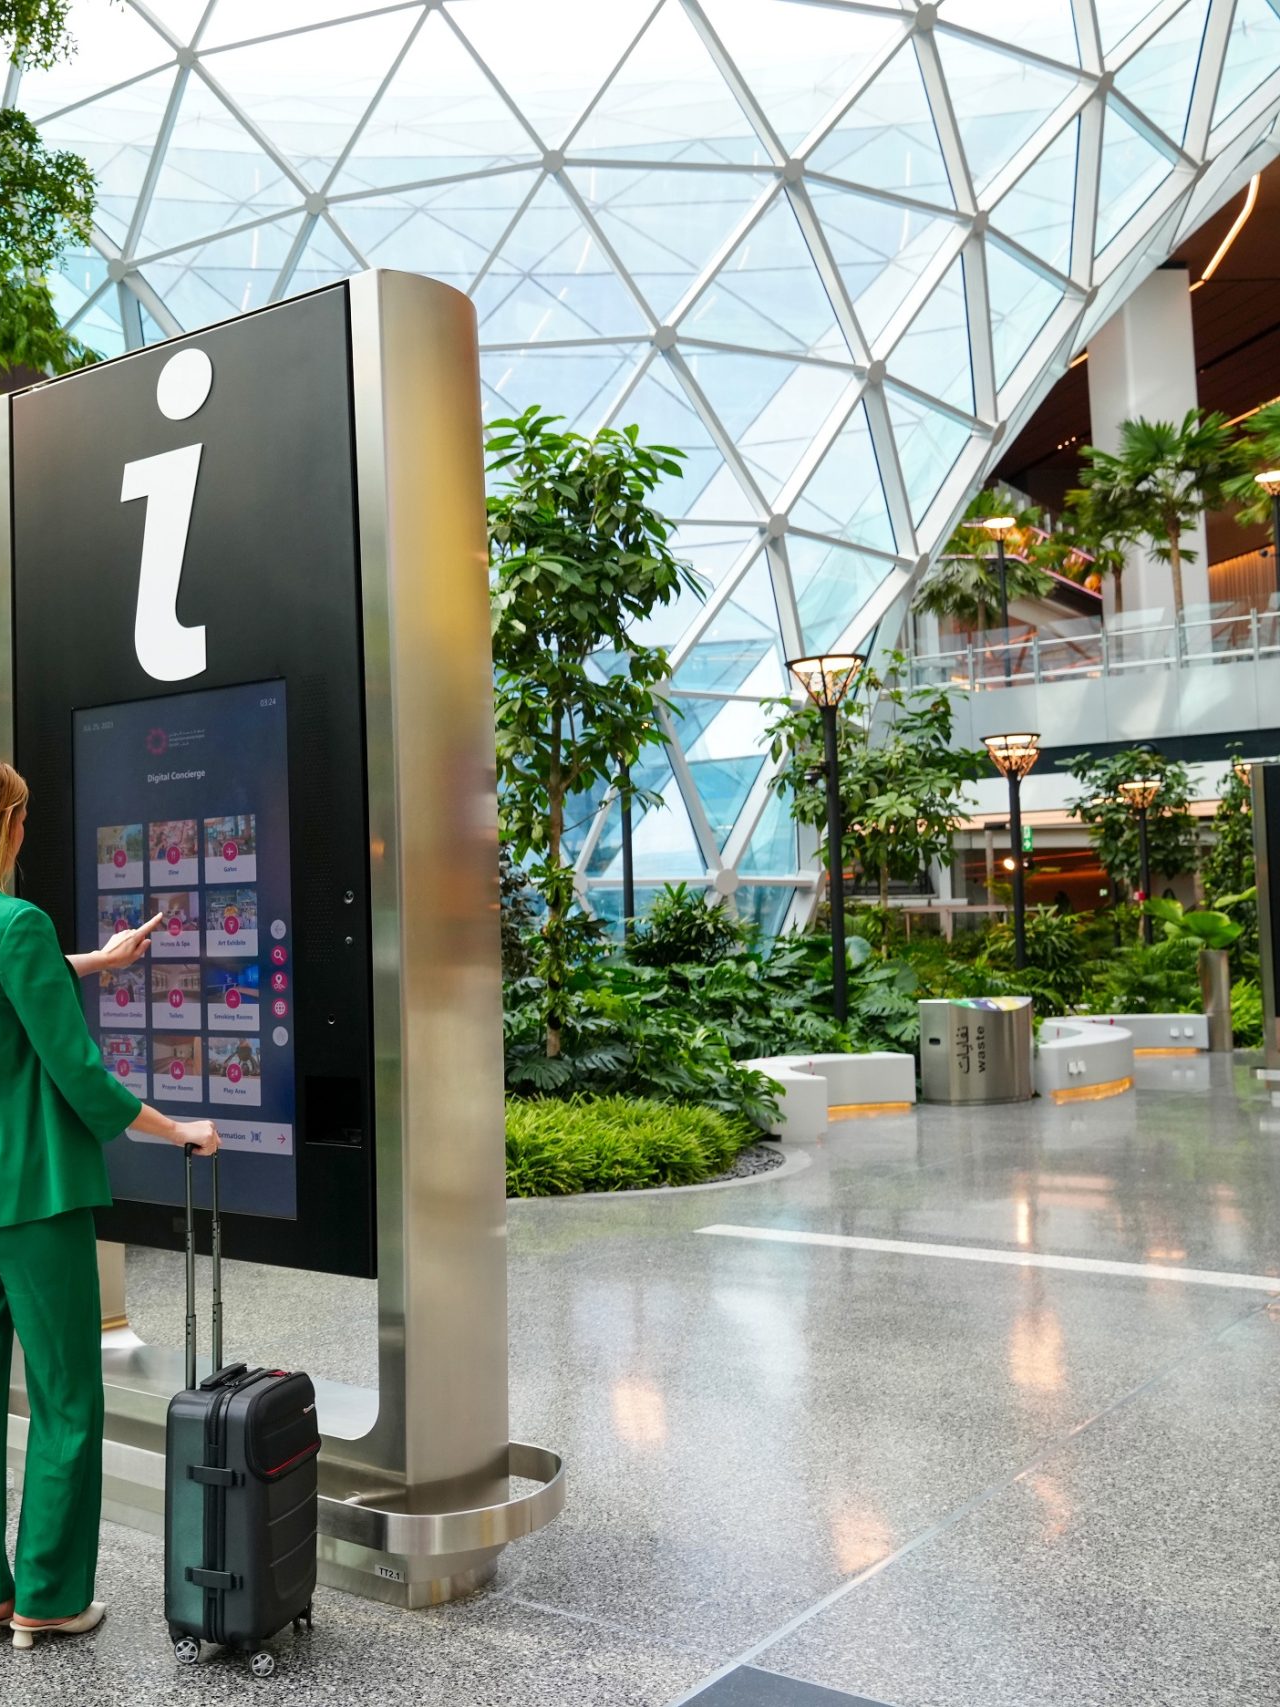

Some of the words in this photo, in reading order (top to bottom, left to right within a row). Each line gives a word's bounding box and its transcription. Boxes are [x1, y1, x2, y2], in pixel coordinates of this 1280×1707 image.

[120, 348, 213, 682] i
[147, 772, 170, 784] Digital
[170, 769, 205, 780] Concierge
[956, 1026, 973, 1074] نفايات
[976, 1026, 986, 1073] waste
[217, 1130, 246, 1140] ormation
[379, 1567, 400, 1580] TT2.1
